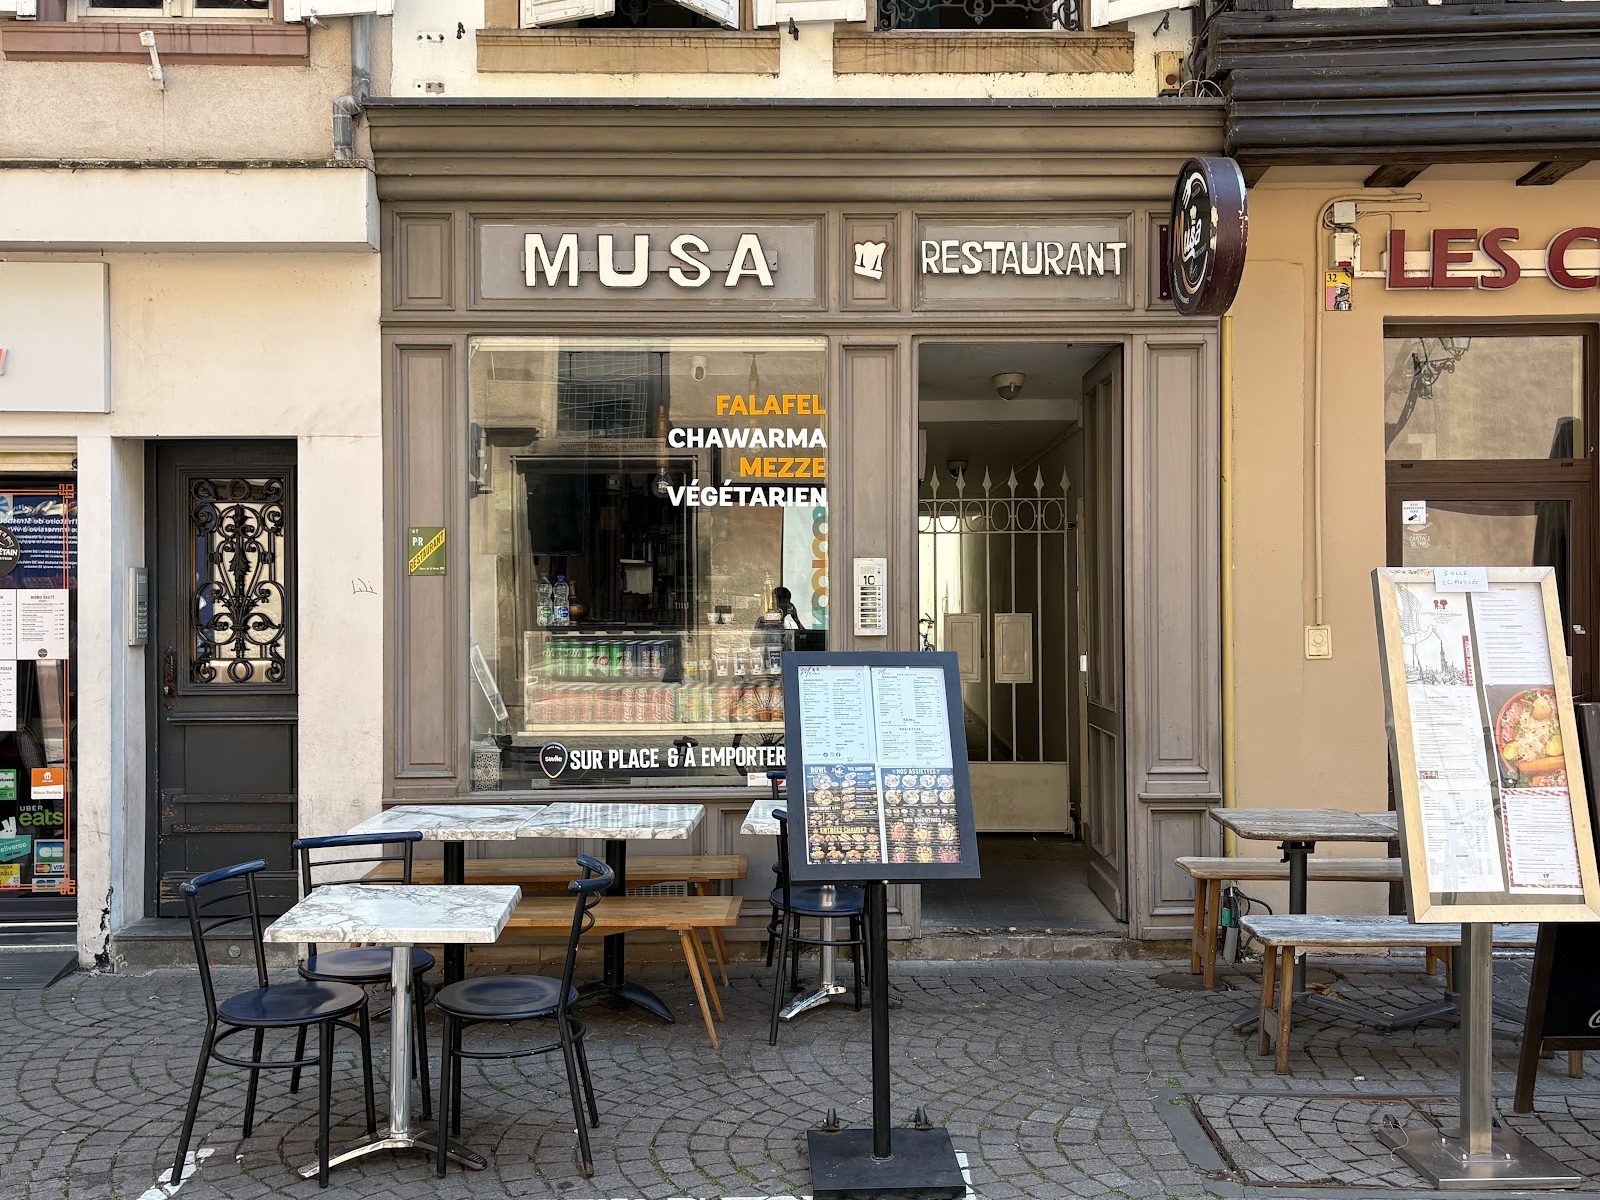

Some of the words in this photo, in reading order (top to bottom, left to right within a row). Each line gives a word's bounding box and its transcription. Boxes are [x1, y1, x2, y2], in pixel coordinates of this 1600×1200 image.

[523, 232, 775, 288] MUSA
[920, 239, 1127, 277] RESTAURANT
[1386, 227, 1521, 290] LES
[1545, 226, 1600, 290] C
[1327, 273, 1337, 283] 32
[716, 393, 827, 417] FALAFEL
[668, 427, 828, 449] CHAWARMA
[739, 457, 827, 478] MEZZE
[666, 478, 828, 507] VÉGÉTARIEN
[412, 536, 424, 547] PR
[570, 749, 604, 770] SUR
[608, 748, 660, 769] PLACE
[683, 742, 697, 767] À
[701, 746, 786, 767] EMPORTER
[19, 809, 64, 827] eats
[0, 842, 27, 853] eliveroo
